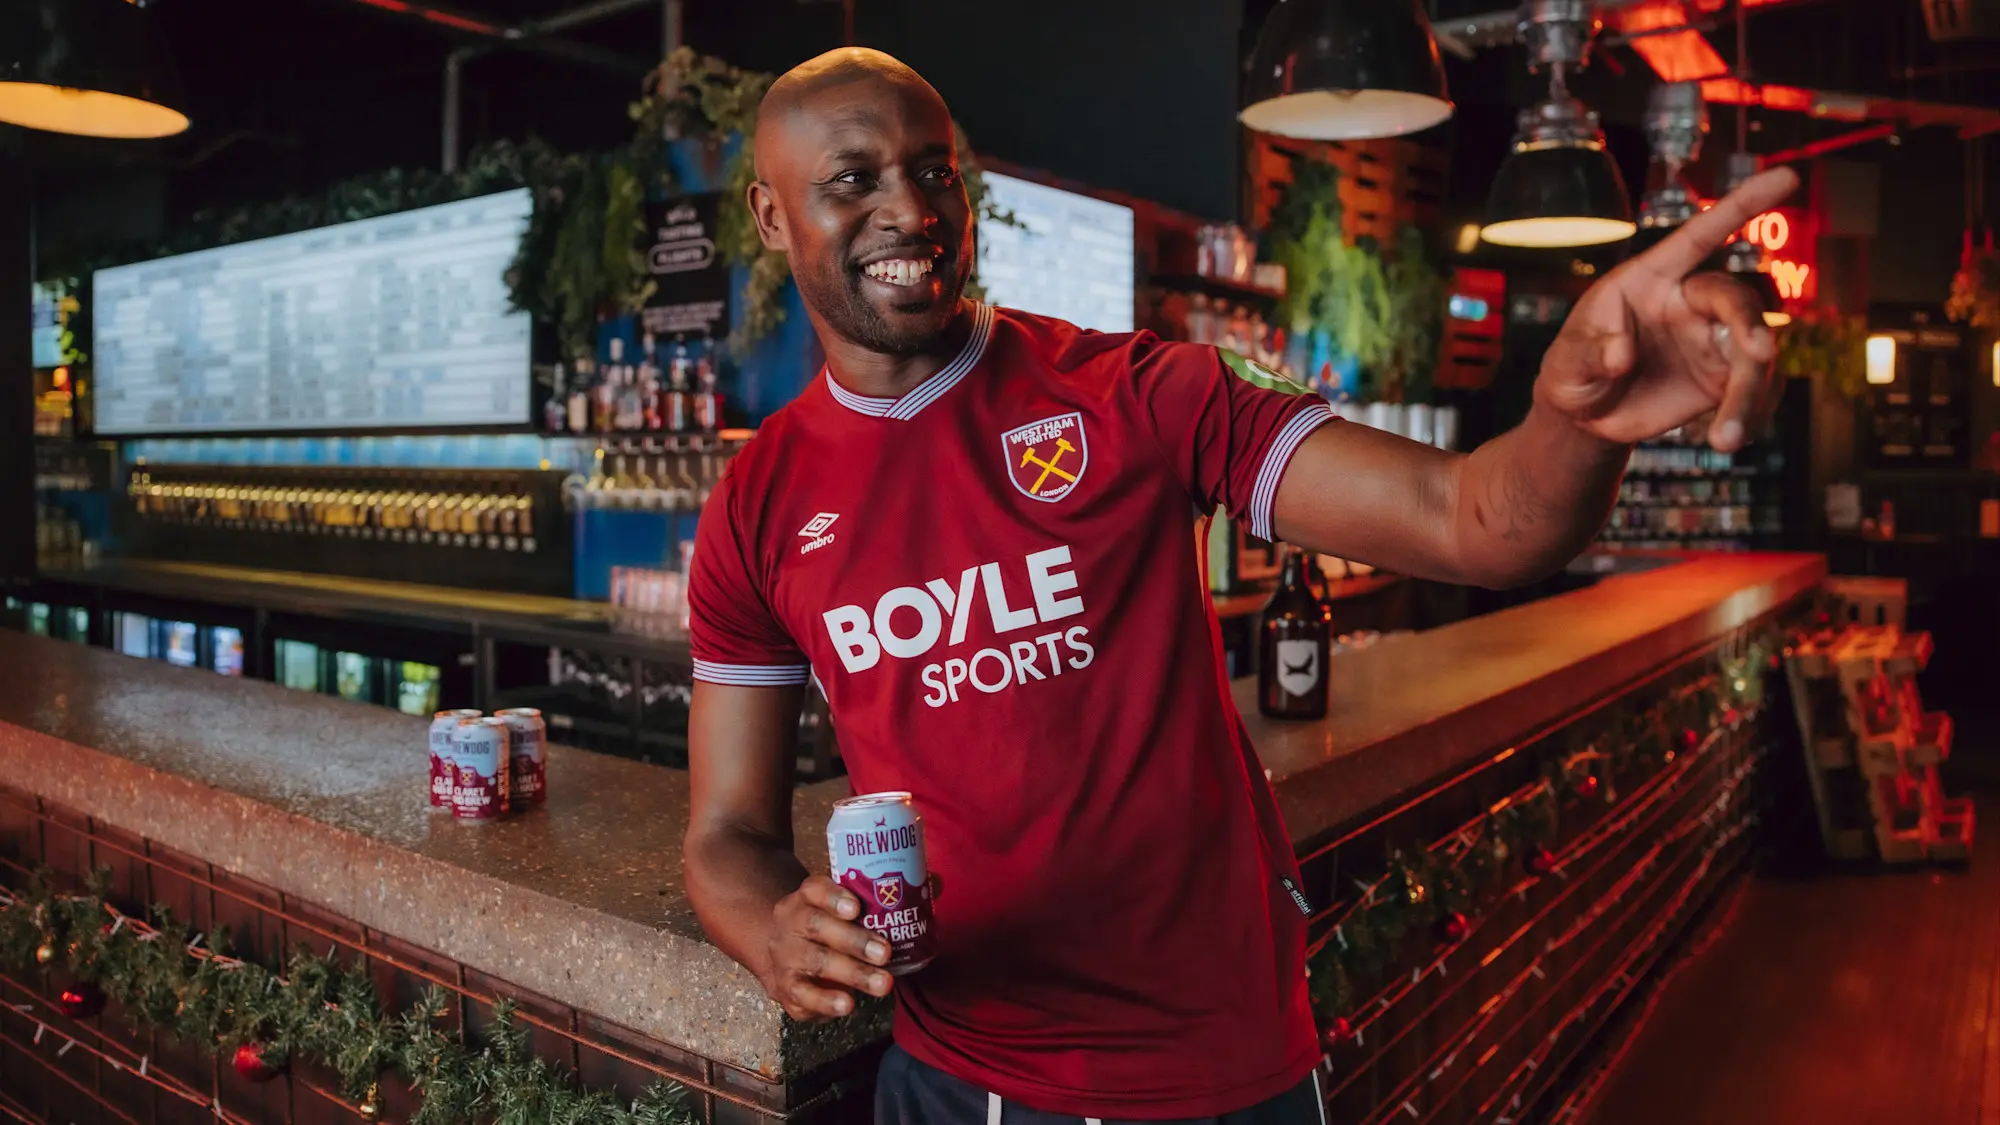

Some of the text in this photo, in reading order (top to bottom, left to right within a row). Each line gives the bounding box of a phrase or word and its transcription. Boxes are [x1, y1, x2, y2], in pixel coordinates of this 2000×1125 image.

[1010, 417, 1075, 444] WEST HAM
[1025, 430, 1063, 446] UNITED
[1039, 484, 1069, 497] LONDON
[800, 533, 836, 555] umbro
[822, 545, 1085, 674] BOYLE
[921, 625, 1095, 708] SPORTS
[846, 825, 917, 856] BREWDOG
[1293, 890, 1311, 913] official
[863, 907, 919, 930] CLARET
[890, 920, 927, 942] BREW
